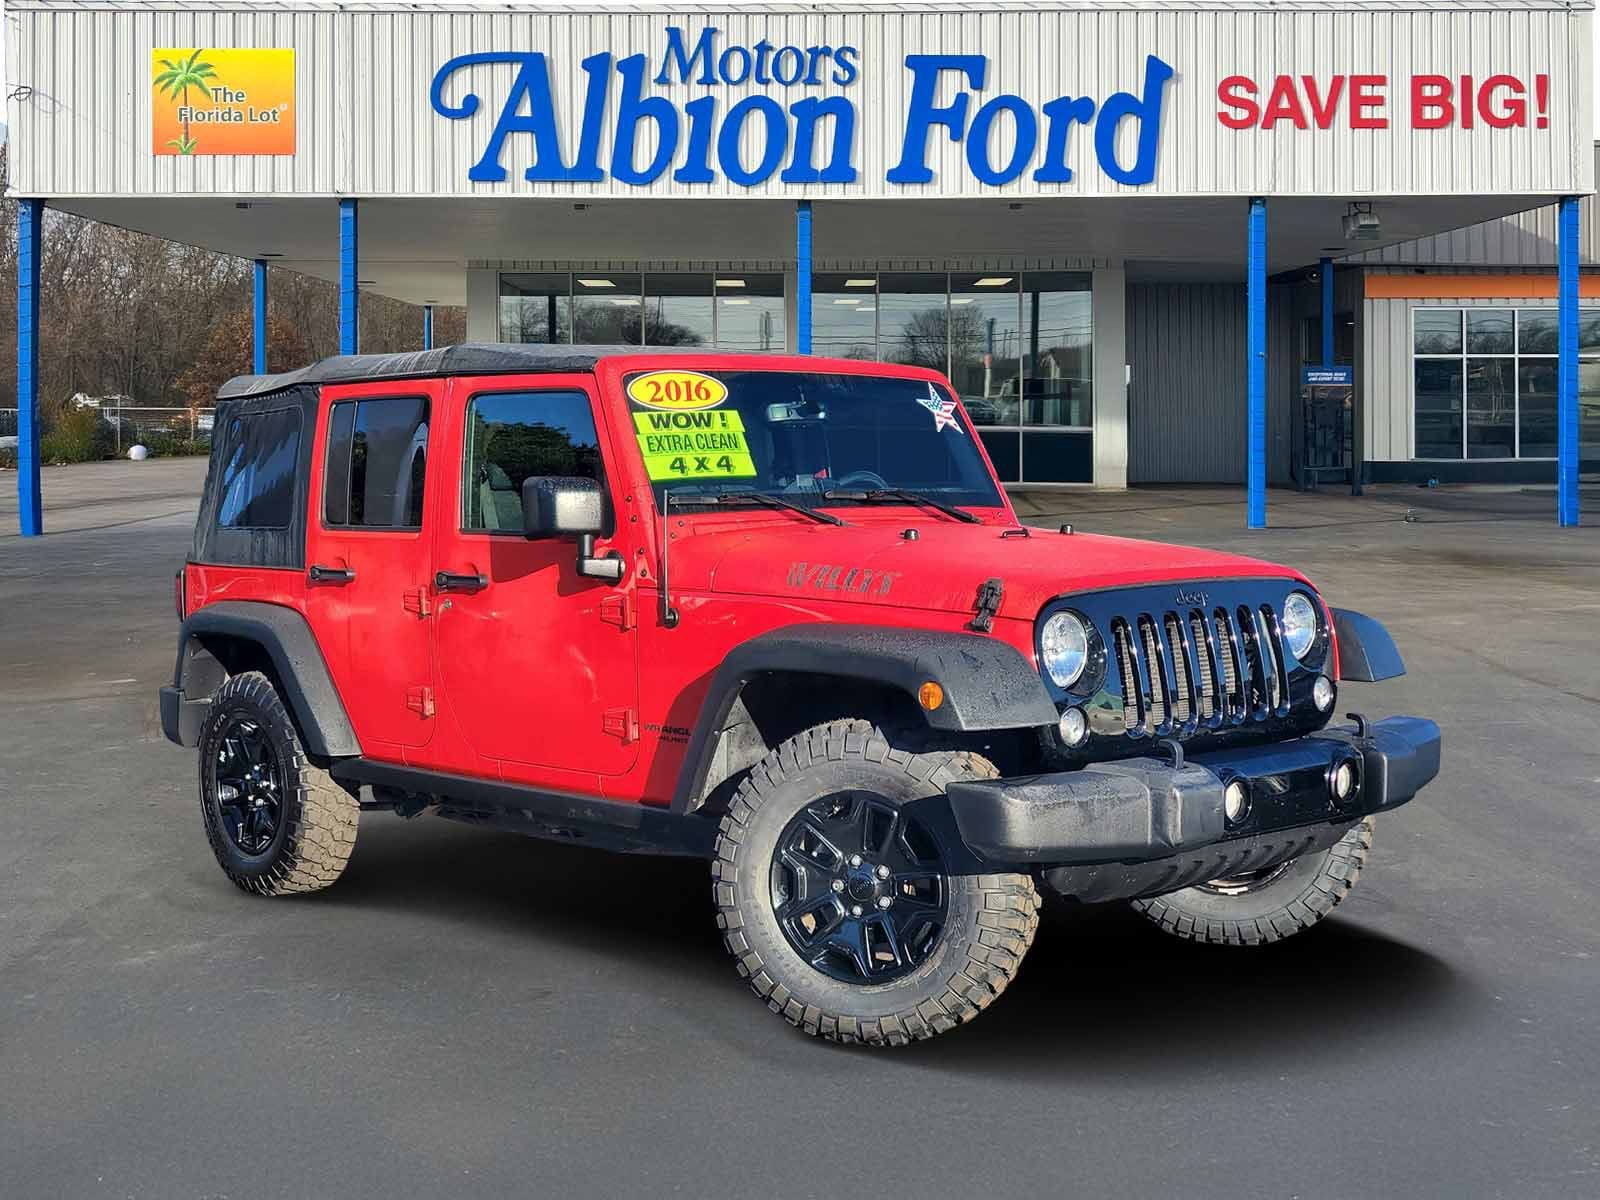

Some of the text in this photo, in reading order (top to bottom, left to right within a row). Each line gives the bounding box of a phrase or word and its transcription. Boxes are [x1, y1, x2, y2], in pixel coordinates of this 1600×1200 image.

[653, 26, 858, 87] Motors
[211, 87, 246, 103] The
[1216, 73, 1550, 130] SAVE BIG!
[178, 106, 280, 123] Florida Lot
[429, 51, 1175, 187] Albion Ford
[646, 379, 712, 403] 2016
[646, 432, 739, 453] EXTRA CLEAN
